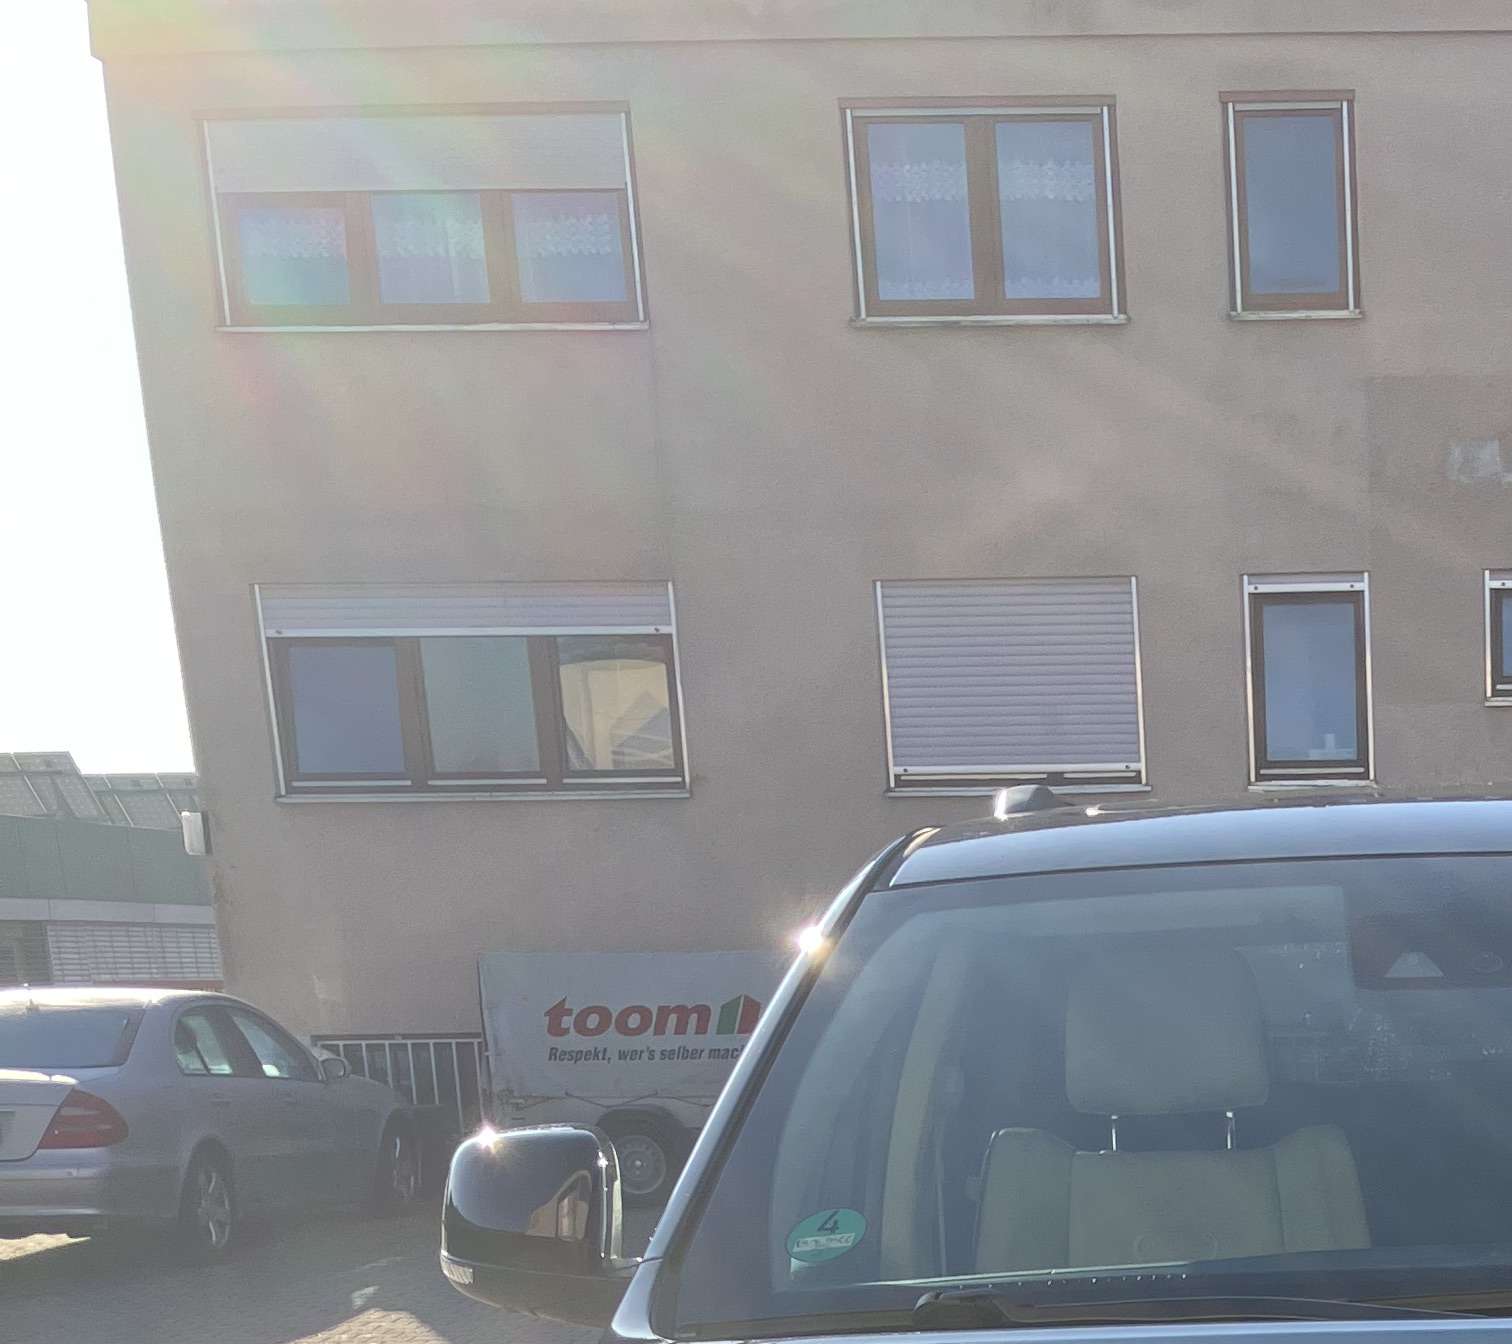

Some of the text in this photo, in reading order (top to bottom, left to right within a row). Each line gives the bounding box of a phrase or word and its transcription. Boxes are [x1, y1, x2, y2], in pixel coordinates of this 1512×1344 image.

[544, 996, 711, 1037] toom
[548, 1047, 611, 1064] Respekt,
[618, 1047, 655, 1061] wer's
[659, 1046, 704, 1060] selber
[816, 1210, 840, 1234] 4
